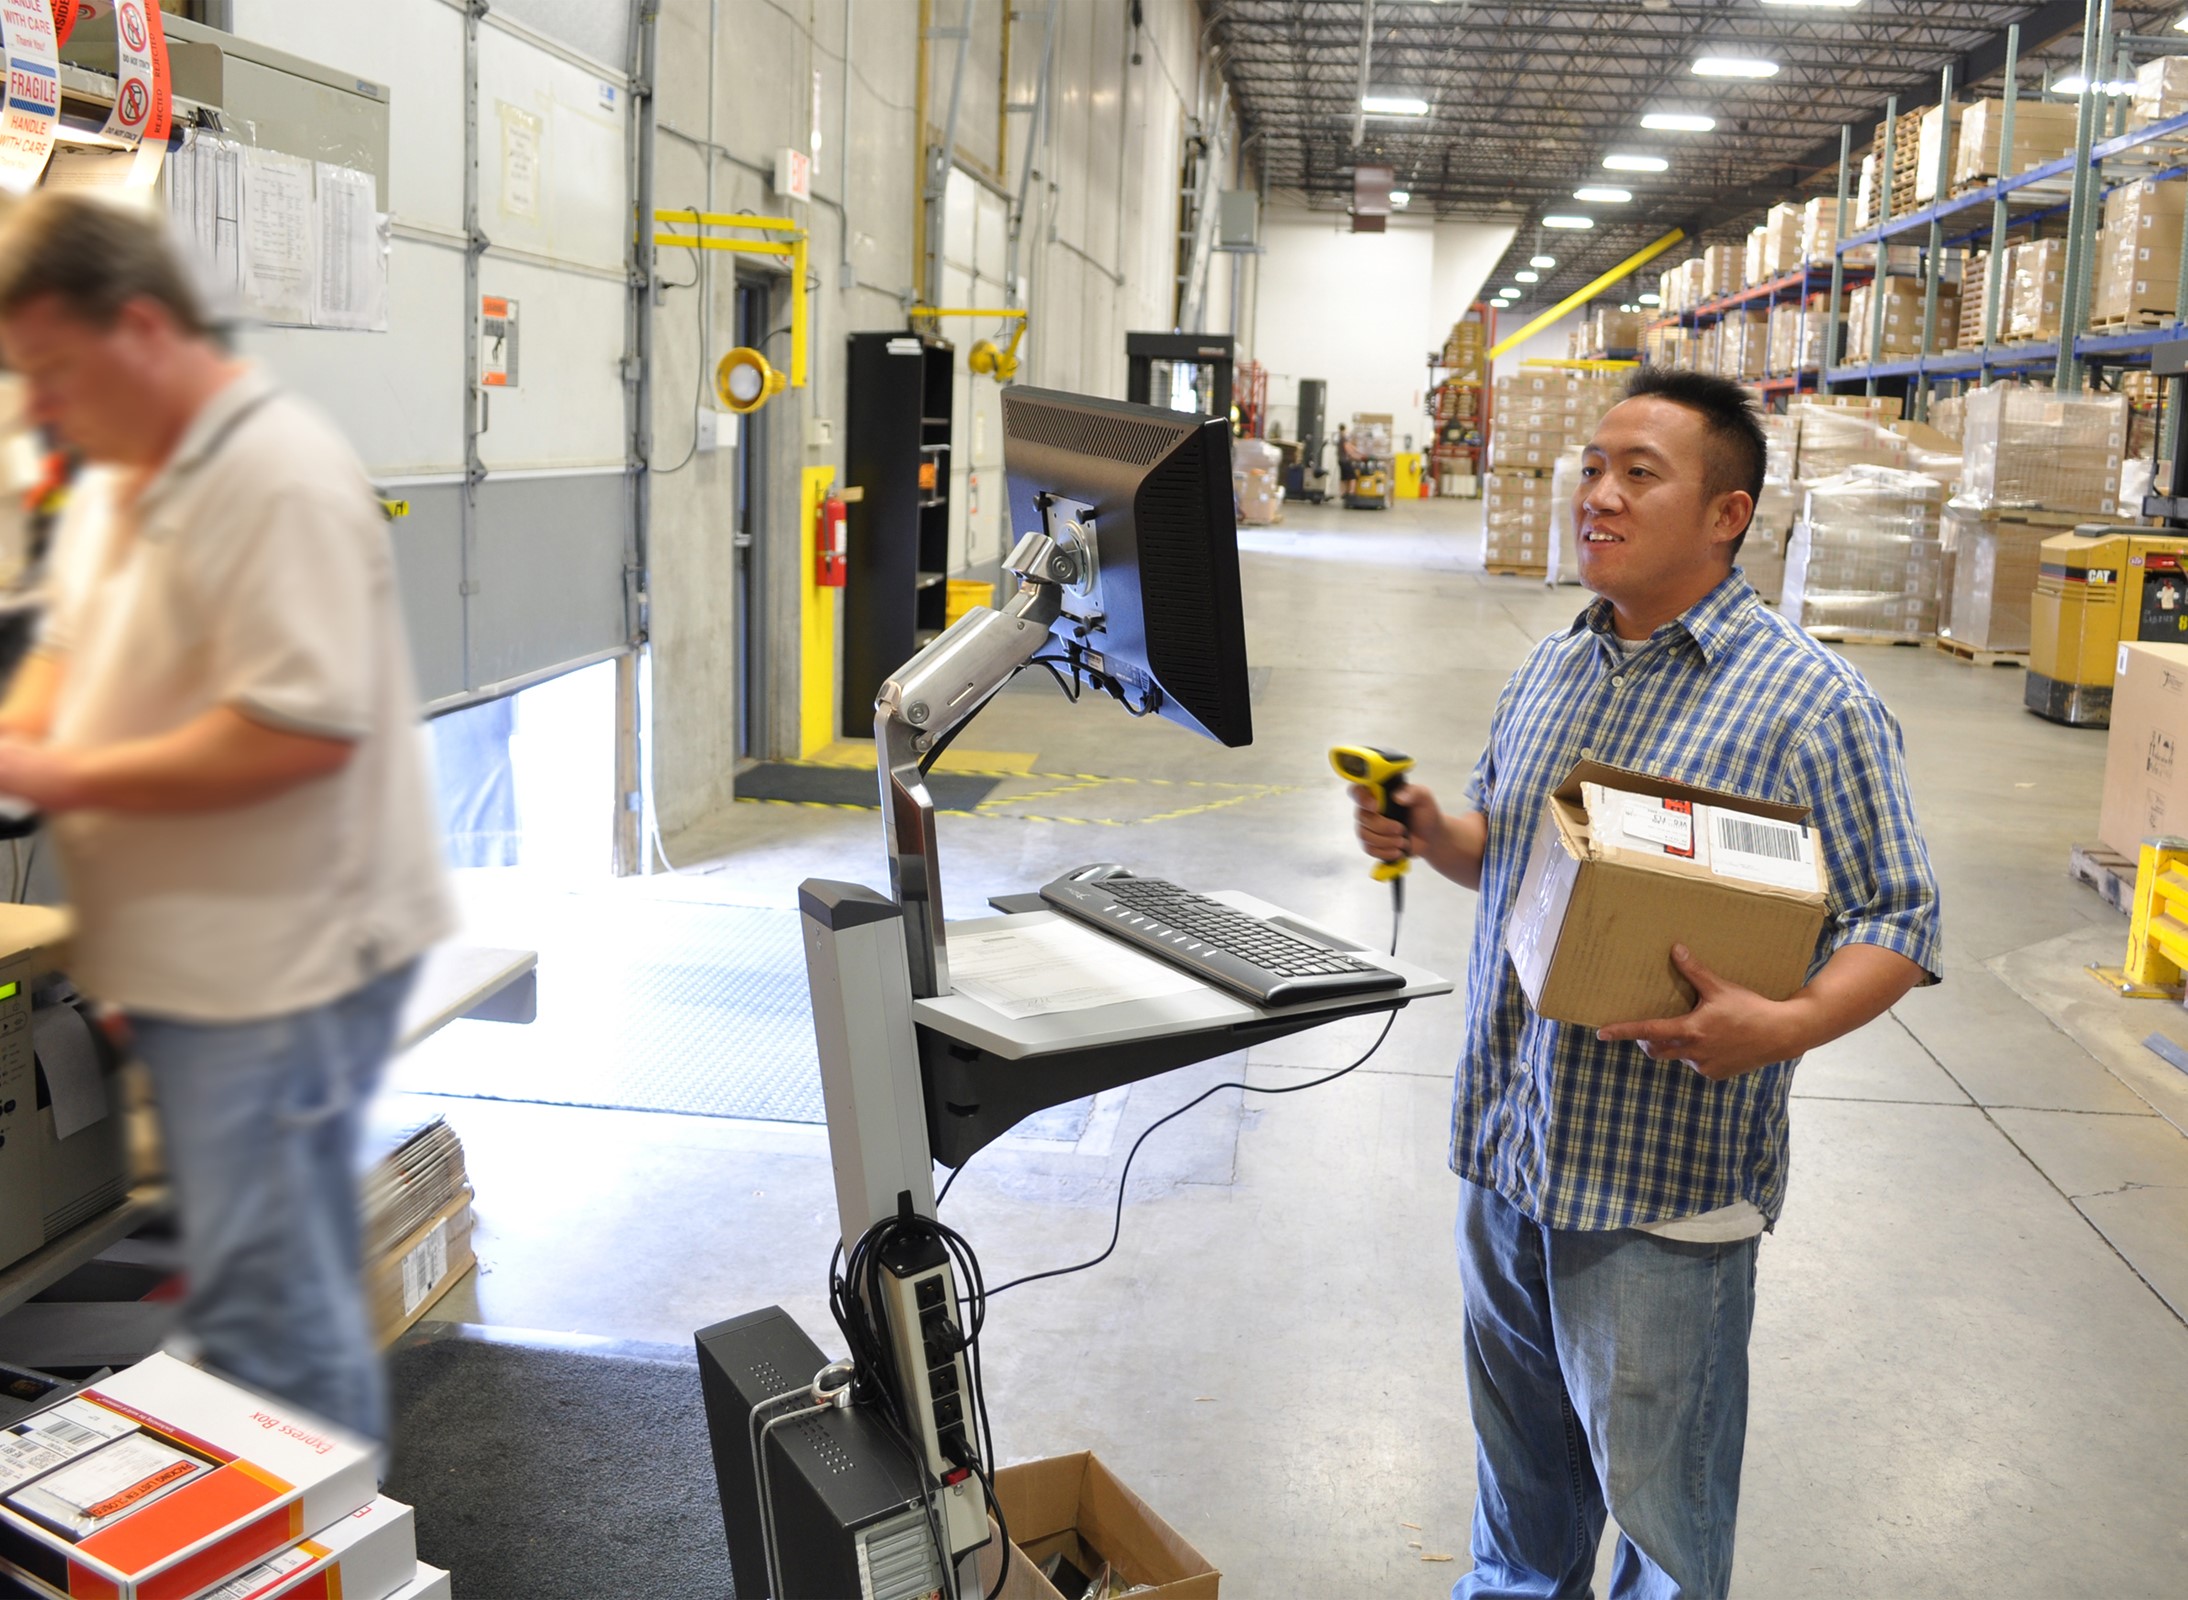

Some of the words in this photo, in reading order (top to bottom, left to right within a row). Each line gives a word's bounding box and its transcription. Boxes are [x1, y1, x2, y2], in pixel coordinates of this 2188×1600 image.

[3, 9, 27, 28] WITH
[28, 16, 52, 36] CARE
[149, 32, 161, 78] REJECTED
[10, 71, 56, 104] FRAGILE
[153, 88, 164, 134] REJECTED
[11, 115, 47, 136] HANDLE
[21, 139, 48, 156] CARE
[2088, 569, 2111, 583] CAT
[248, 1411, 280, 1430] Box
[278, 1425, 333, 1455] Express
[155, 1463, 193, 1483] PACKING
[137, 1480, 157, 1494] LIST
